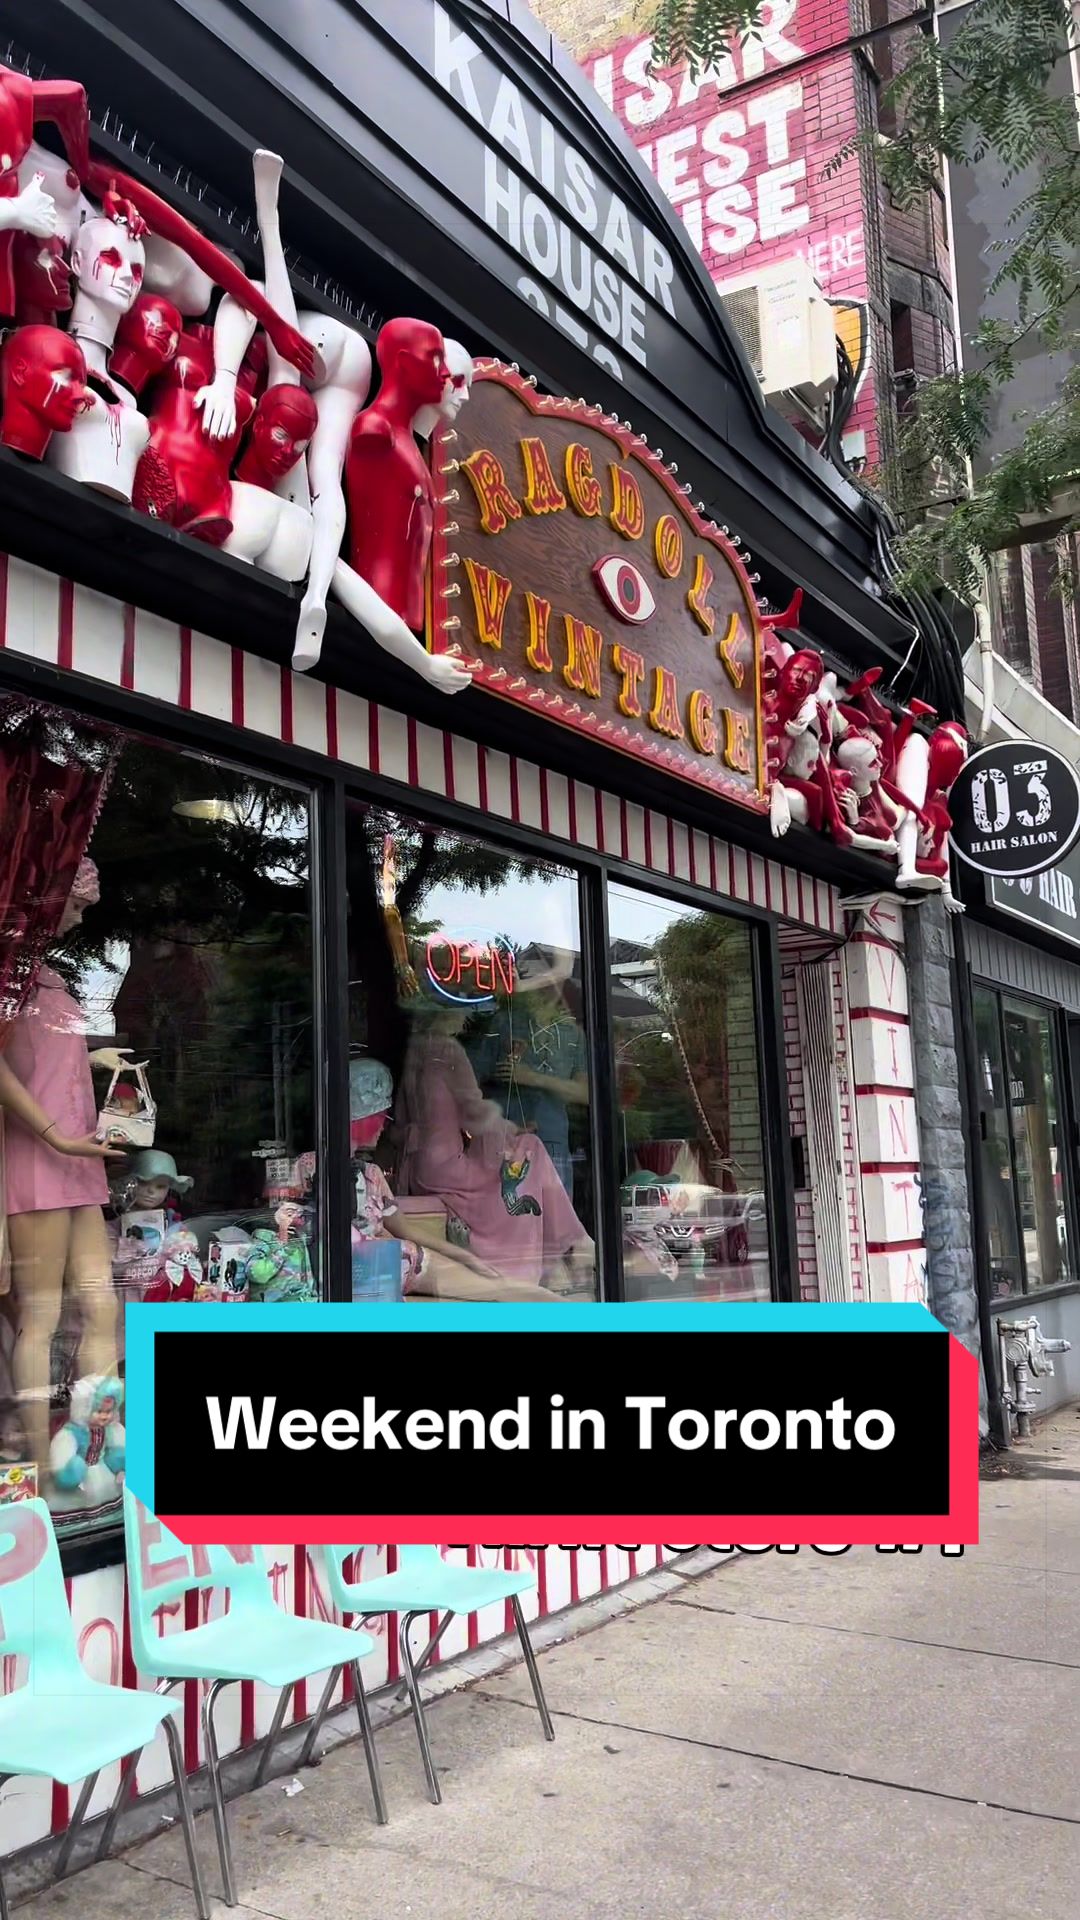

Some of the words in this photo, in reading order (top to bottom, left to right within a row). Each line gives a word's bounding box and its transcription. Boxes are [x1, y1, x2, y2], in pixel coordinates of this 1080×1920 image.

[434, 8, 677, 320] KAISAR
[484, 145, 647, 368] HOUSE
[461, 437, 747, 689] RAGDOLL
[462, 557, 752, 775] VINTAGE
[970, 838, 1007, 854] HAIR
[1010, 831, 1058, 848] SALON
[971, 760, 1051, 833] 03
[427, 934, 513, 994] OPEN
[1039, 868, 1077, 919] HAIR
